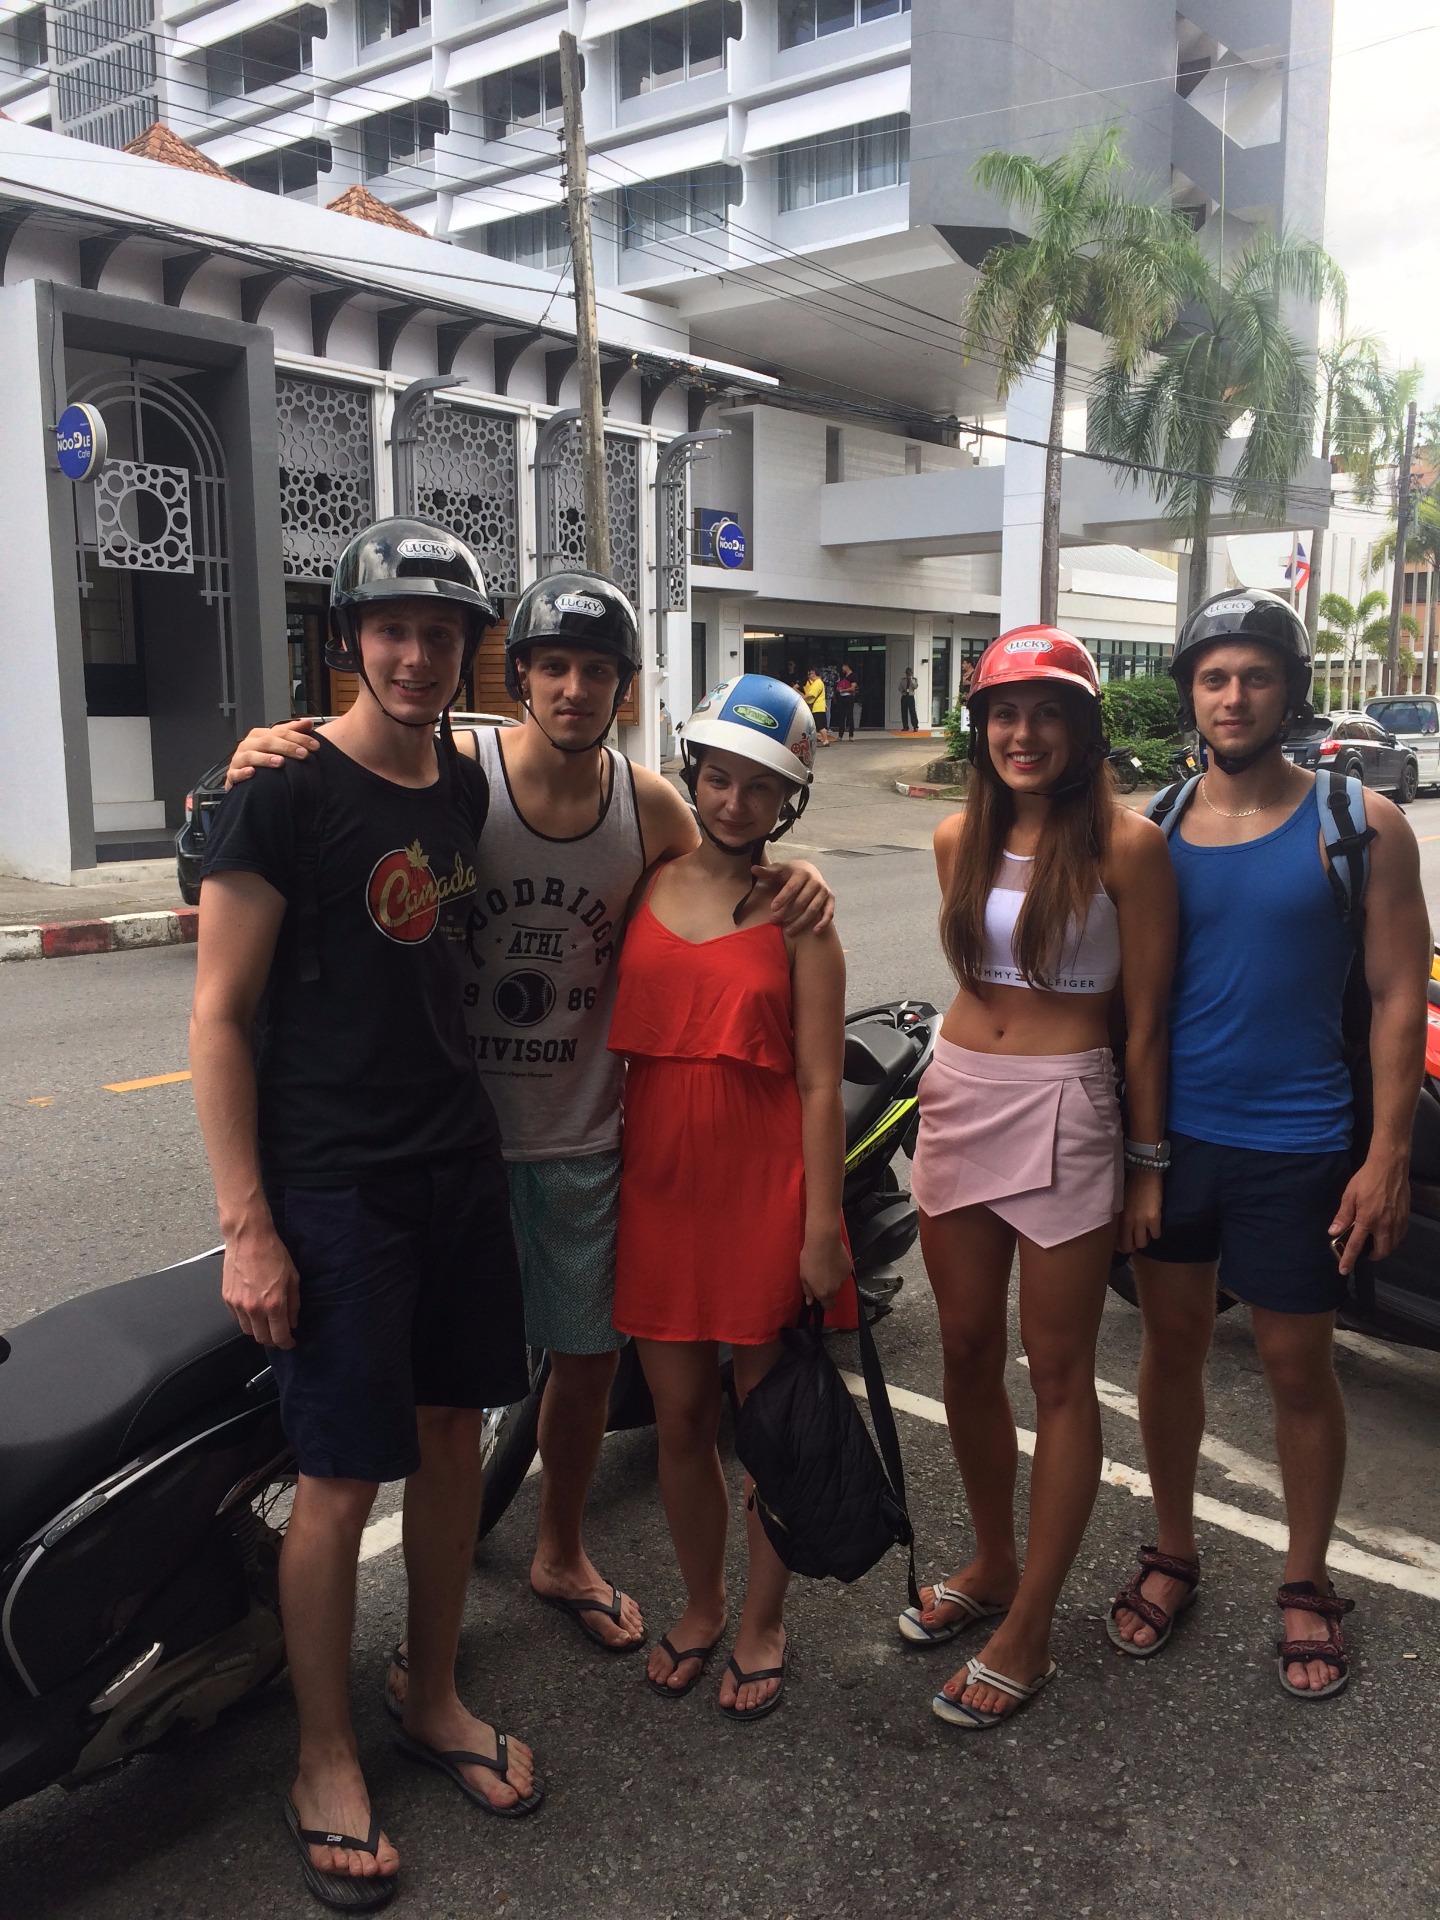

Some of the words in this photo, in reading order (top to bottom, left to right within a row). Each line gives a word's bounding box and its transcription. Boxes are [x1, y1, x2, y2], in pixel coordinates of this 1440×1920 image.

[57, 431, 91, 451] NOODLE
[405, 543, 449, 556] LUCKY
[719, 539, 745, 551] NOODLE
[561, 598, 600, 612] LUCKY
[1209, 602, 1247, 613] LUCKY
[1010, 640, 1047, 650] LUCKY
[379, 851, 477, 928] Canada
[468, 877, 614, 967] OODRIDGE
[507, 930, 564, 958] ATHL
[983, 969, 1012, 979] MMY
[1046, 977, 1095, 988] LFIGER
[568, 987, 598, 1012] 86
